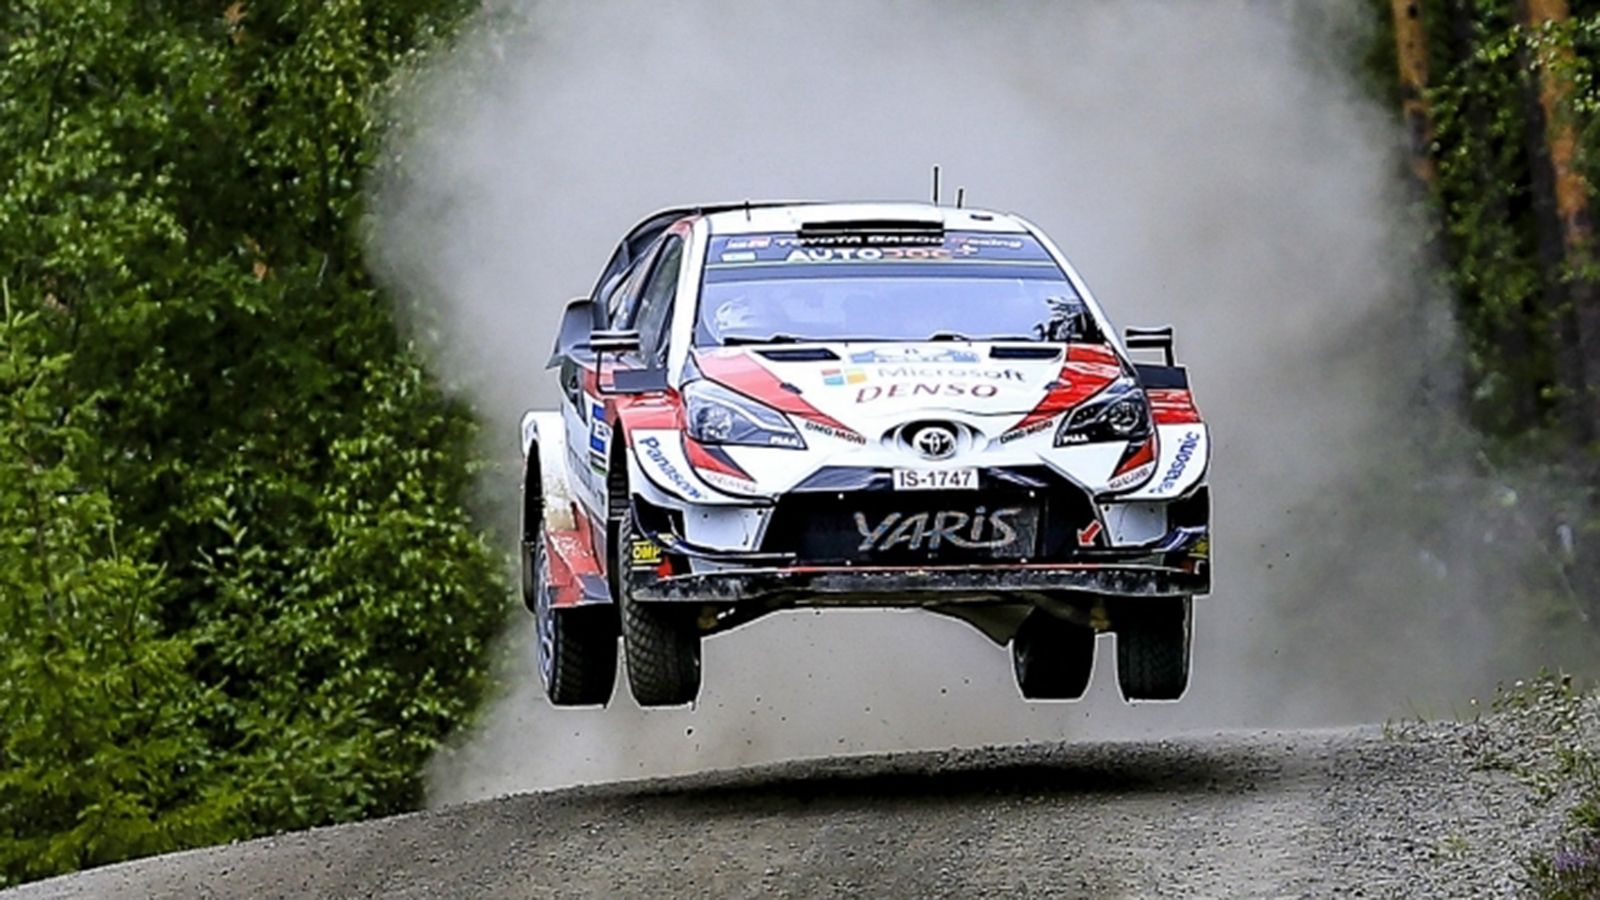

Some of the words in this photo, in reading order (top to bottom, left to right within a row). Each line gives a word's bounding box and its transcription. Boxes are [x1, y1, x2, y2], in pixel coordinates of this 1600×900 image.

[878, 366, 1025, 383] Microsoft
[855, 383, 998, 403] DENSO
[899, 471, 972, 487] IS-1747
